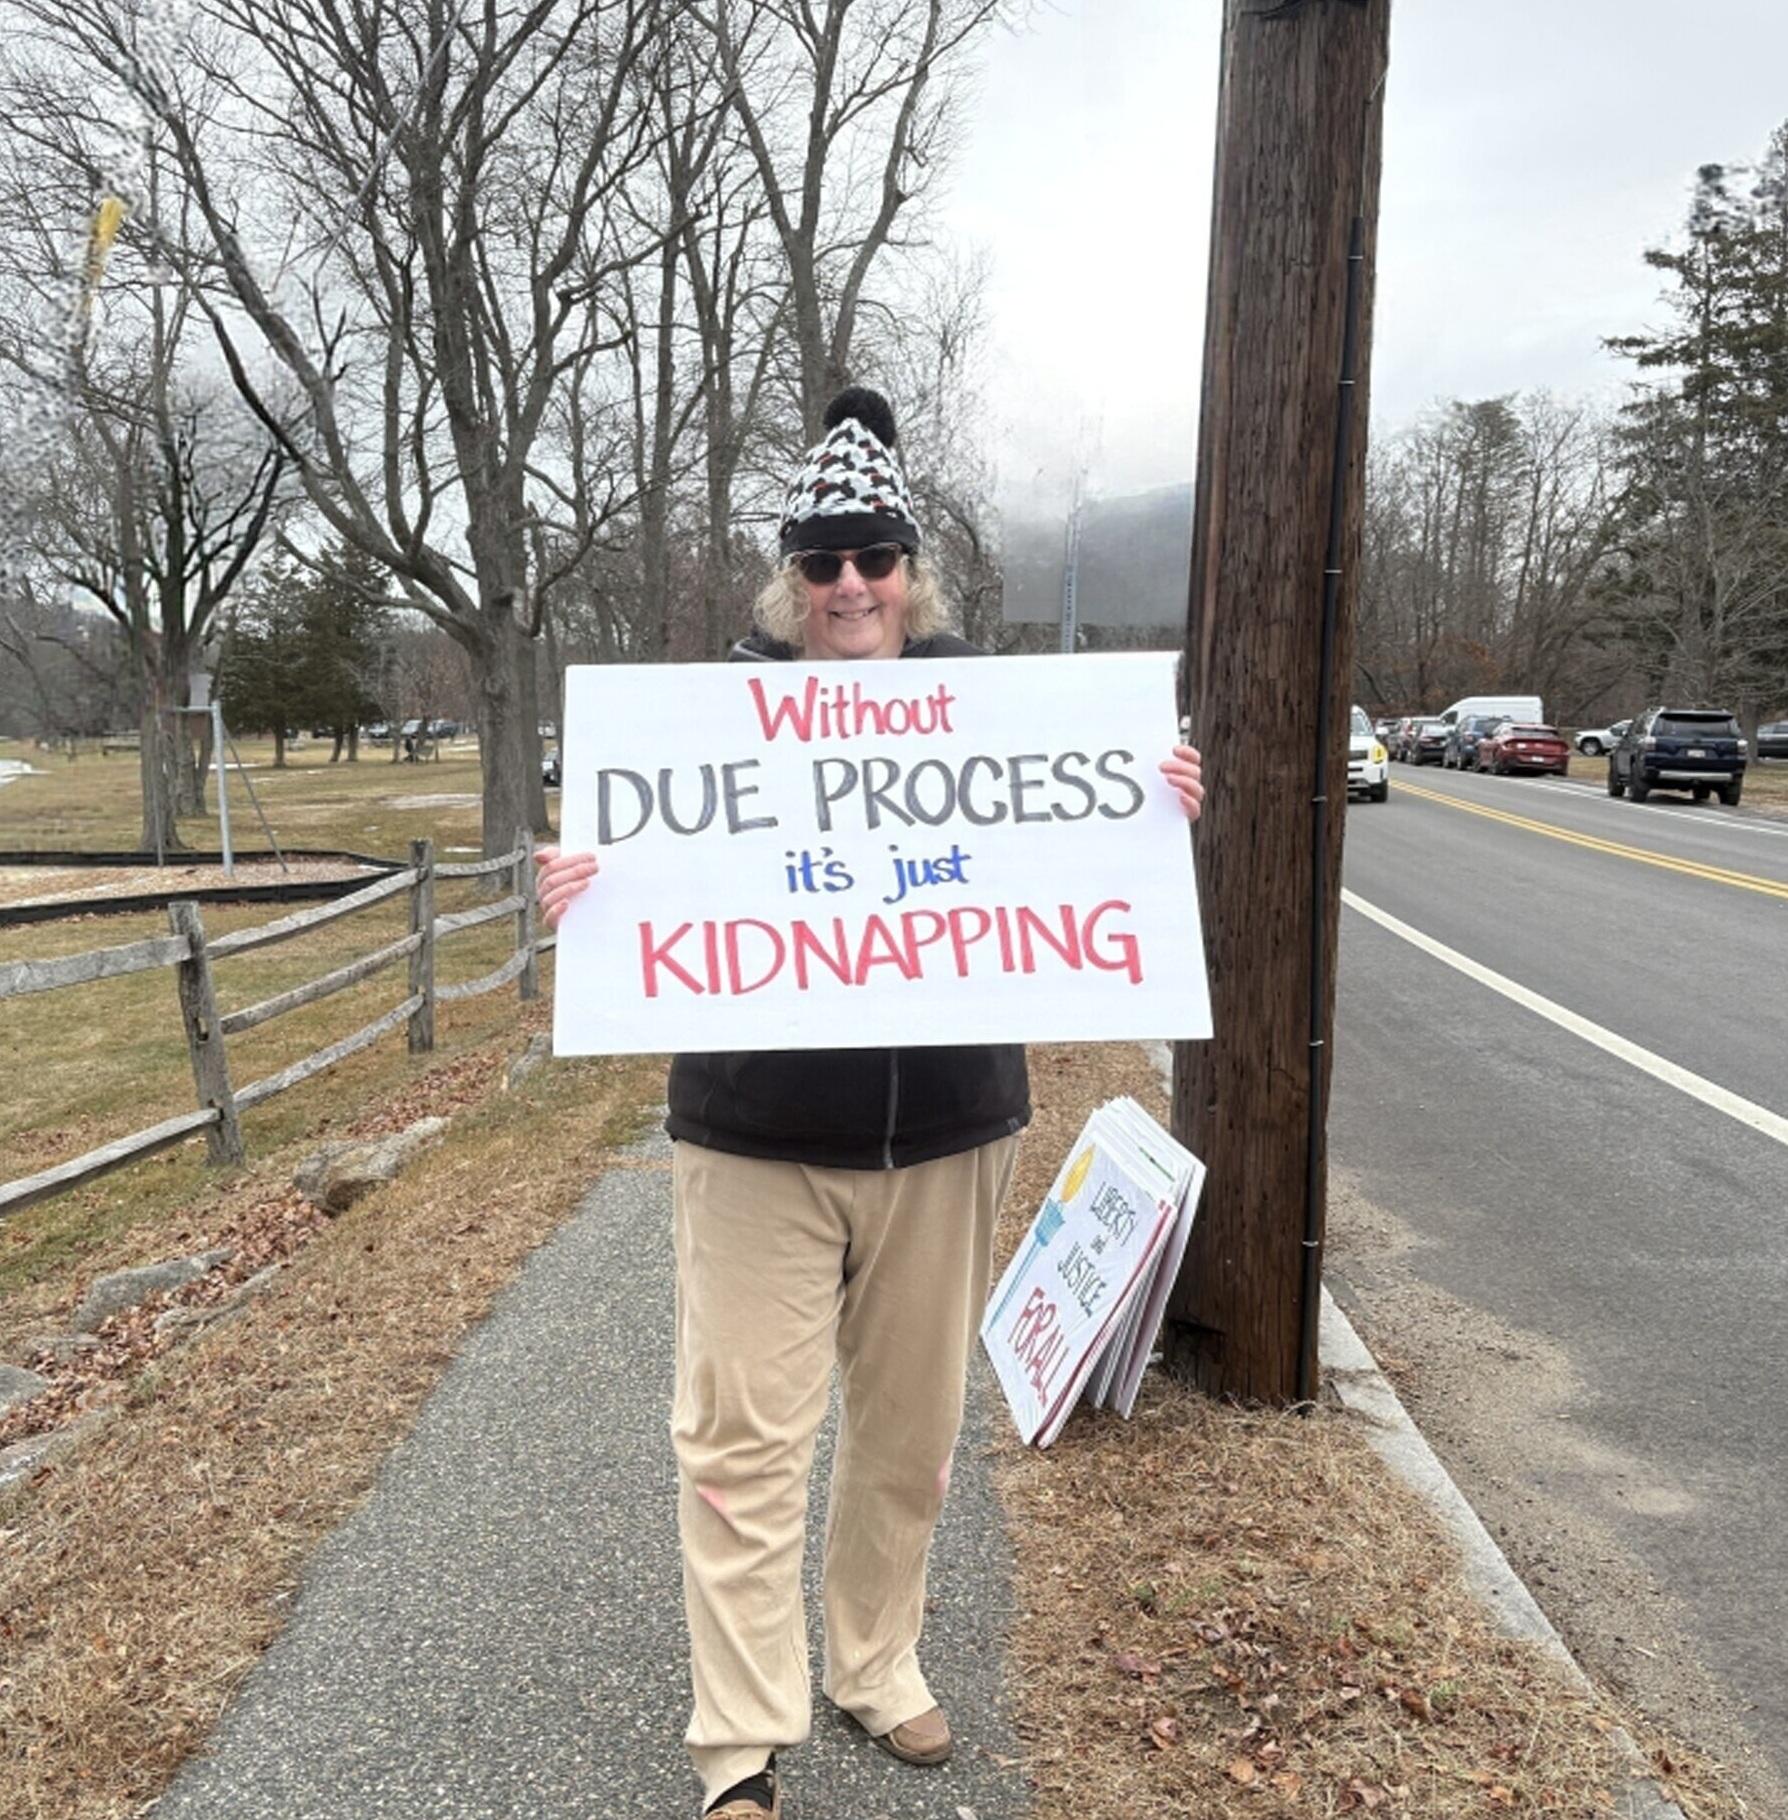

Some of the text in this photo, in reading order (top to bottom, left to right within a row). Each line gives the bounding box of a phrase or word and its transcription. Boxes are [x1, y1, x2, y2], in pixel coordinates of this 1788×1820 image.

[748, 675, 955, 742] Without
[597, 749, 1144, 845] DUE PROCESS
[785, 844, 971, 904] it's just
[638, 899, 1143, 998] KIDNAPPING
[1090, 1181, 1138, 1247] LIBERTY
[1057, 1241, 1107, 1318] JUSTICE
[1007, 1286, 1070, 1408] FOR ALL
